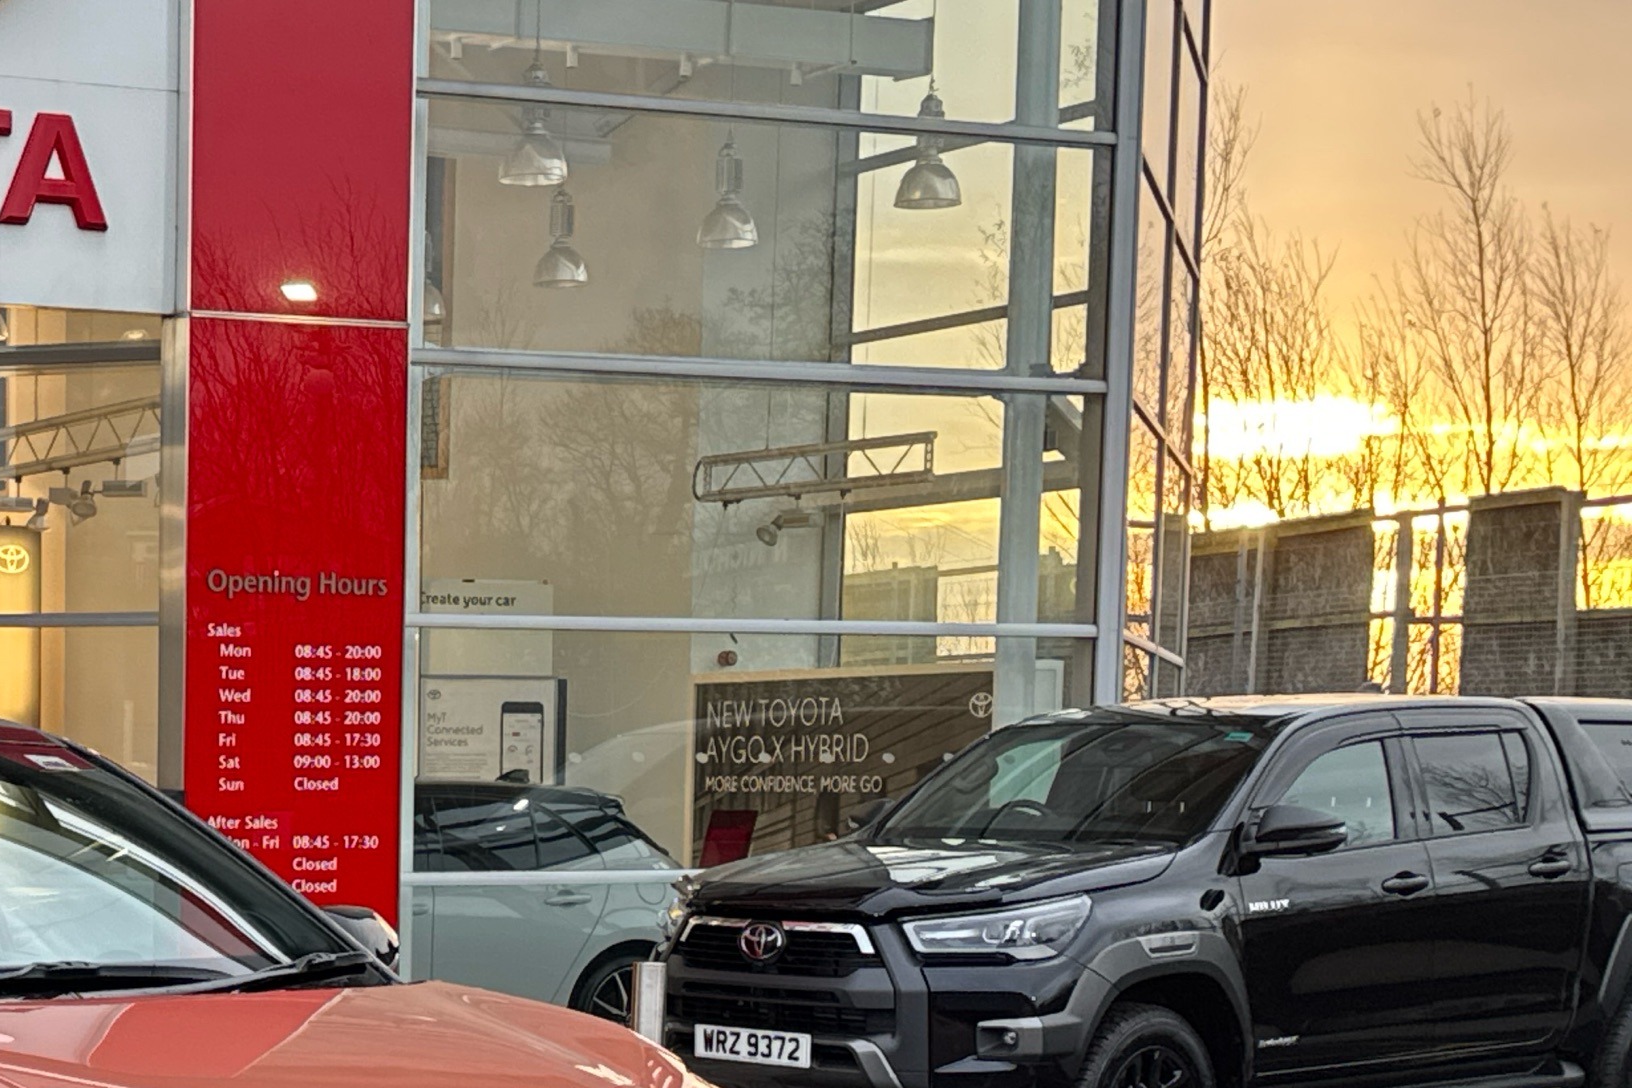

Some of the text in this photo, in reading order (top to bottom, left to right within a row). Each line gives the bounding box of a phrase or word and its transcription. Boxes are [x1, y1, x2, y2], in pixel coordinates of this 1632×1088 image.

[207, 568, 388, 601] Opening Hours
[463, 595, 493, 609] your
[495, 596, 516, 607] car
[208, 623, 241, 637] Sales
[220, 644, 251, 657] Mon
[295, 645, 332, 658] 08:45
[345, 646, 381, 659] 20:00
[220, 666, 244, 679] Tue
[295, 667, 332, 680] 08:45
[346, 668, 381, 681] 18:00
[219, 689, 251, 702] Wed
[295, 689, 332, 702] 08:45
[344, 690, 381, 703] 20:00
[219, 711, 244, 724] Thu
[295, 711, 331, 724] 08:45
[344, 711, 380, 724] 20:00
[706, 697, 844, 729] NEW TOYOTA
[426, 725, 484, 735] Connected
[219, 733, 235, 746] Fri
[294, 733, 331, 746] 08:45
[345, 733, 380, 746] 17:30
[426, 737, 469, 747] Services
[707, 733, 869, 764] AYGO X HYBRID
[219, 755, 240, 769] Sat
[294, 755, 331, 768] 09:00
[345, 755, 380, 768] 13:00
[219, 777, 338, 791] Sun Closed
[704, 776, 738, 793] MORE
[820, 775, 857, 793] MORE
[860, 775, 882, 793] GO
[207, 815, 278, 829] After Sales
[263, 836, 279, 848] Fri
[293, 836, 329, 849] 08:45
[344, 836, 378, 848] 17:30
[293, 857, 337, 870] Closed
[292, 879, 337, 894] Closed
[703, 1028, 800, 1062] WRZ 9372
